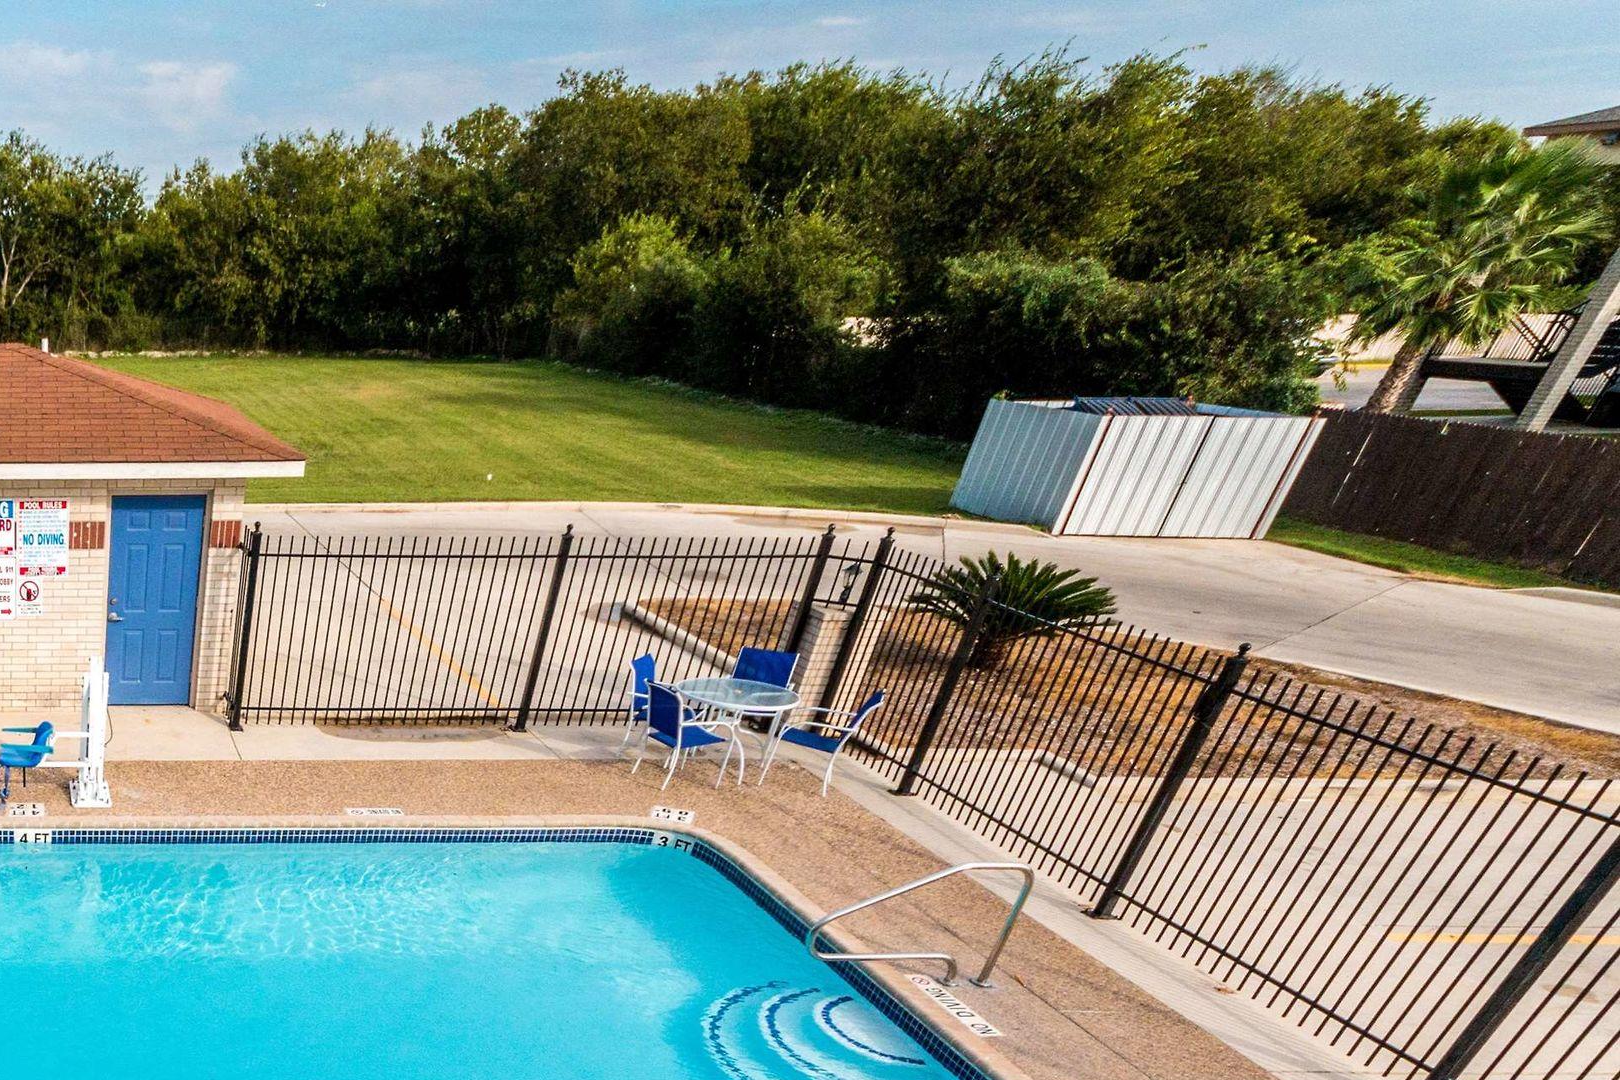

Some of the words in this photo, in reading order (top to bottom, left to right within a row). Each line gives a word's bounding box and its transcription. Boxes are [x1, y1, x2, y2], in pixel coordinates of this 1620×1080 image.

[23, 533, 35, 545] NO
[20, 833, 28, 843] 4
[34, 833, 50, 844] FT
[657, 836, 669, 847] 3
[674, 839, 692, 852] FT
[925, 987, 975, 1018] DIVING
